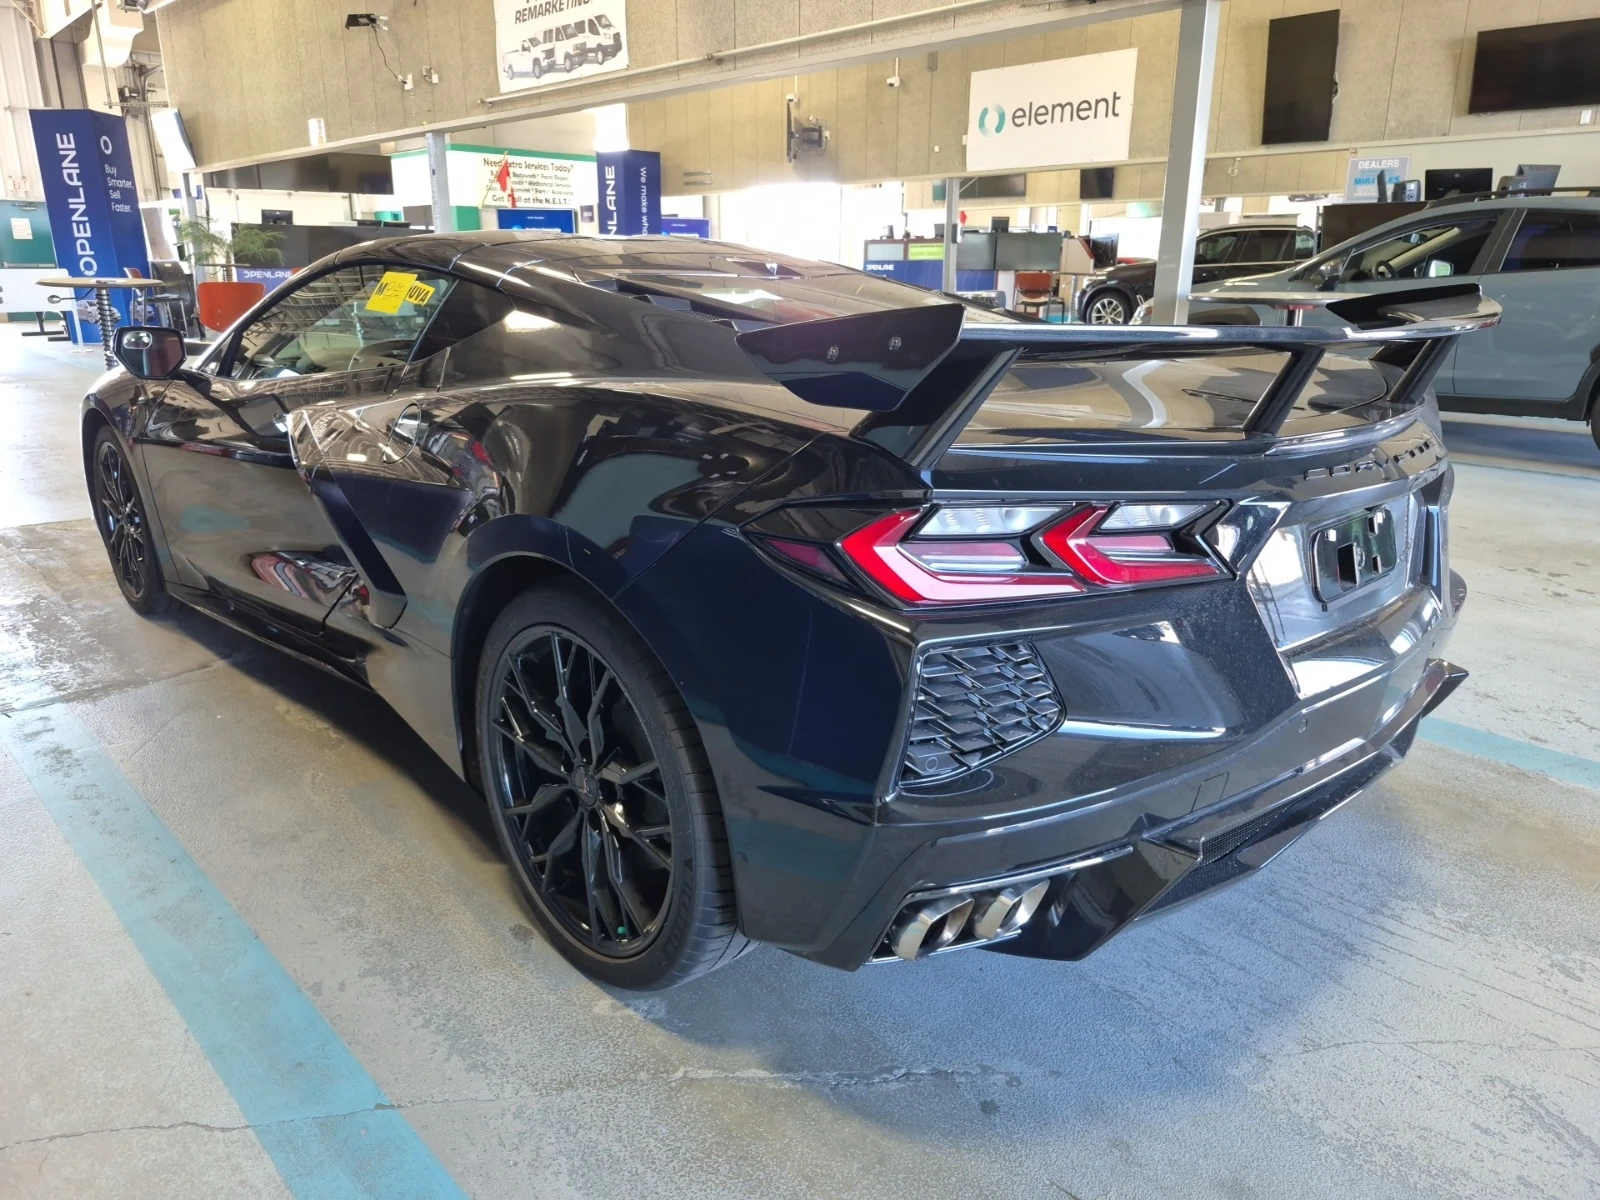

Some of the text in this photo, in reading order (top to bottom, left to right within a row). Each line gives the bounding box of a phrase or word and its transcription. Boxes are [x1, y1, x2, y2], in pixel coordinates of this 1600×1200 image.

[1012, 91, 1121, 127] element
[104, 163, 117, 177] Buy
[506, 161, 523, 169] xtra
[1358, 159, 1399, 169] DEALERS
[106, 176, 134, 190] Smarter,
[1354, 176, 1400, 185] MIRAES
[109, 189, 121, 200] Sell
[492, 193, 505, 203] Get
[532, 196, 544, 205] the
[56, 132, 98, 276] OPENLANE
